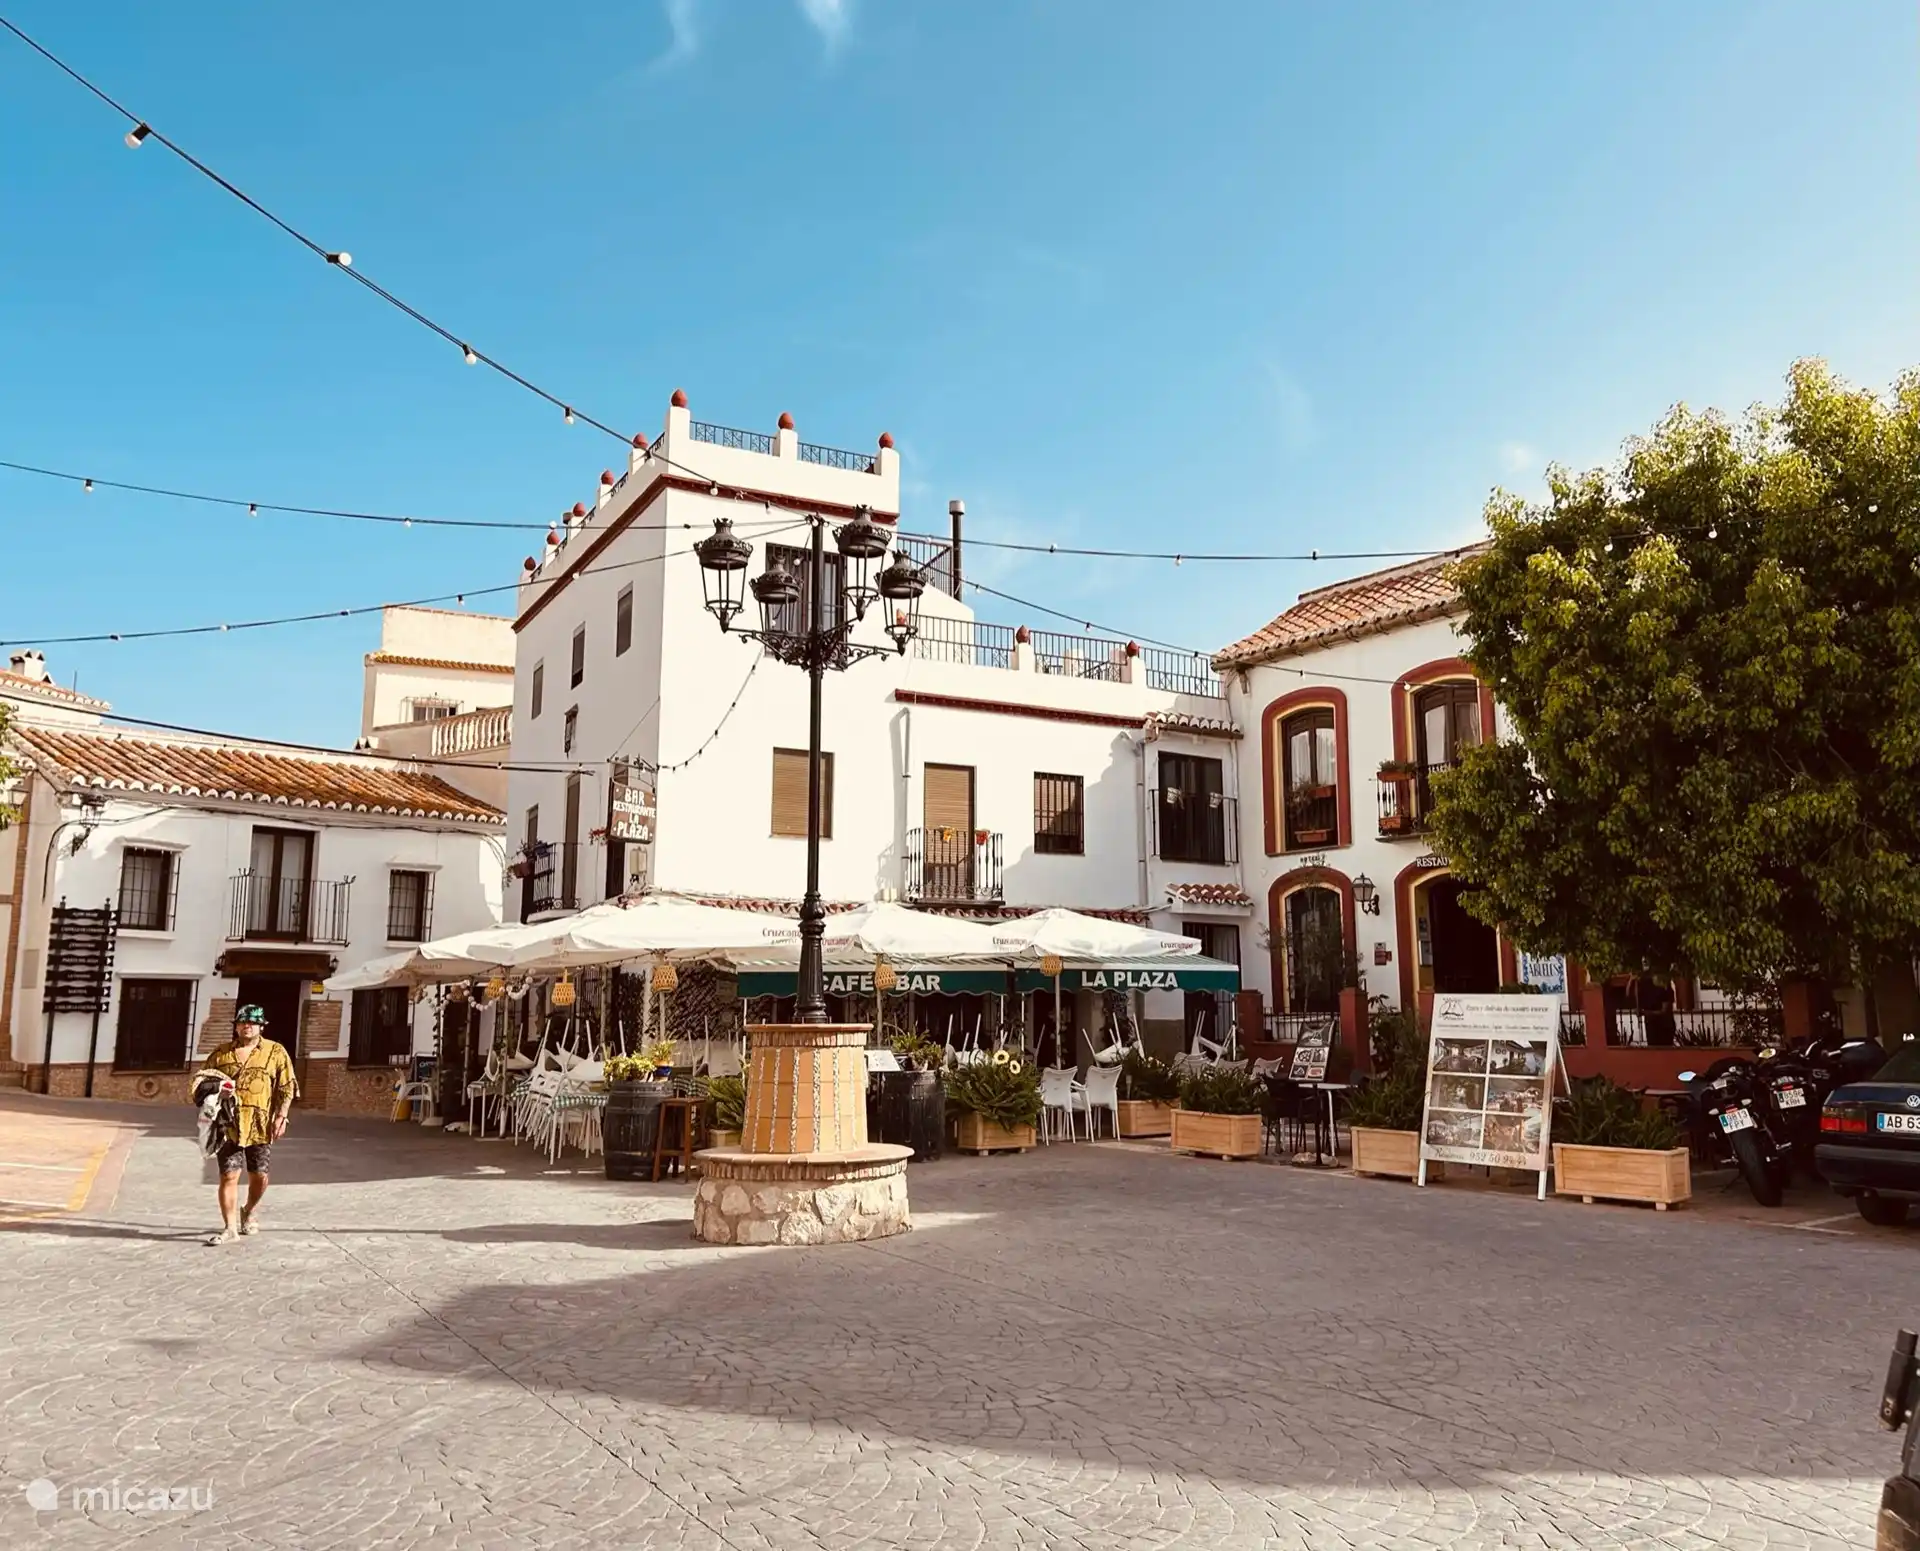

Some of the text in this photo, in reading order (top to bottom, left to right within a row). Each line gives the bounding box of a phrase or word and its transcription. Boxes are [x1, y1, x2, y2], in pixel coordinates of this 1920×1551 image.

[625, 788, 645, 805] BAR
[613, 800, 656, 818] RESTAURANTE
[629, 812, 639, 825] LA
[616, 821, 649, 840] PLAZA
[1416, 856, 1450, 867] RESTAU
[762, 928, 800, 938] Cruzcam
[895, 975, 940, 991] BAR
[1081, 971, 1178, 988] LA PLAZA
[1726, 1110, 1748, 1122] 9813
[1887, 1115, 1902, 1128] AB
